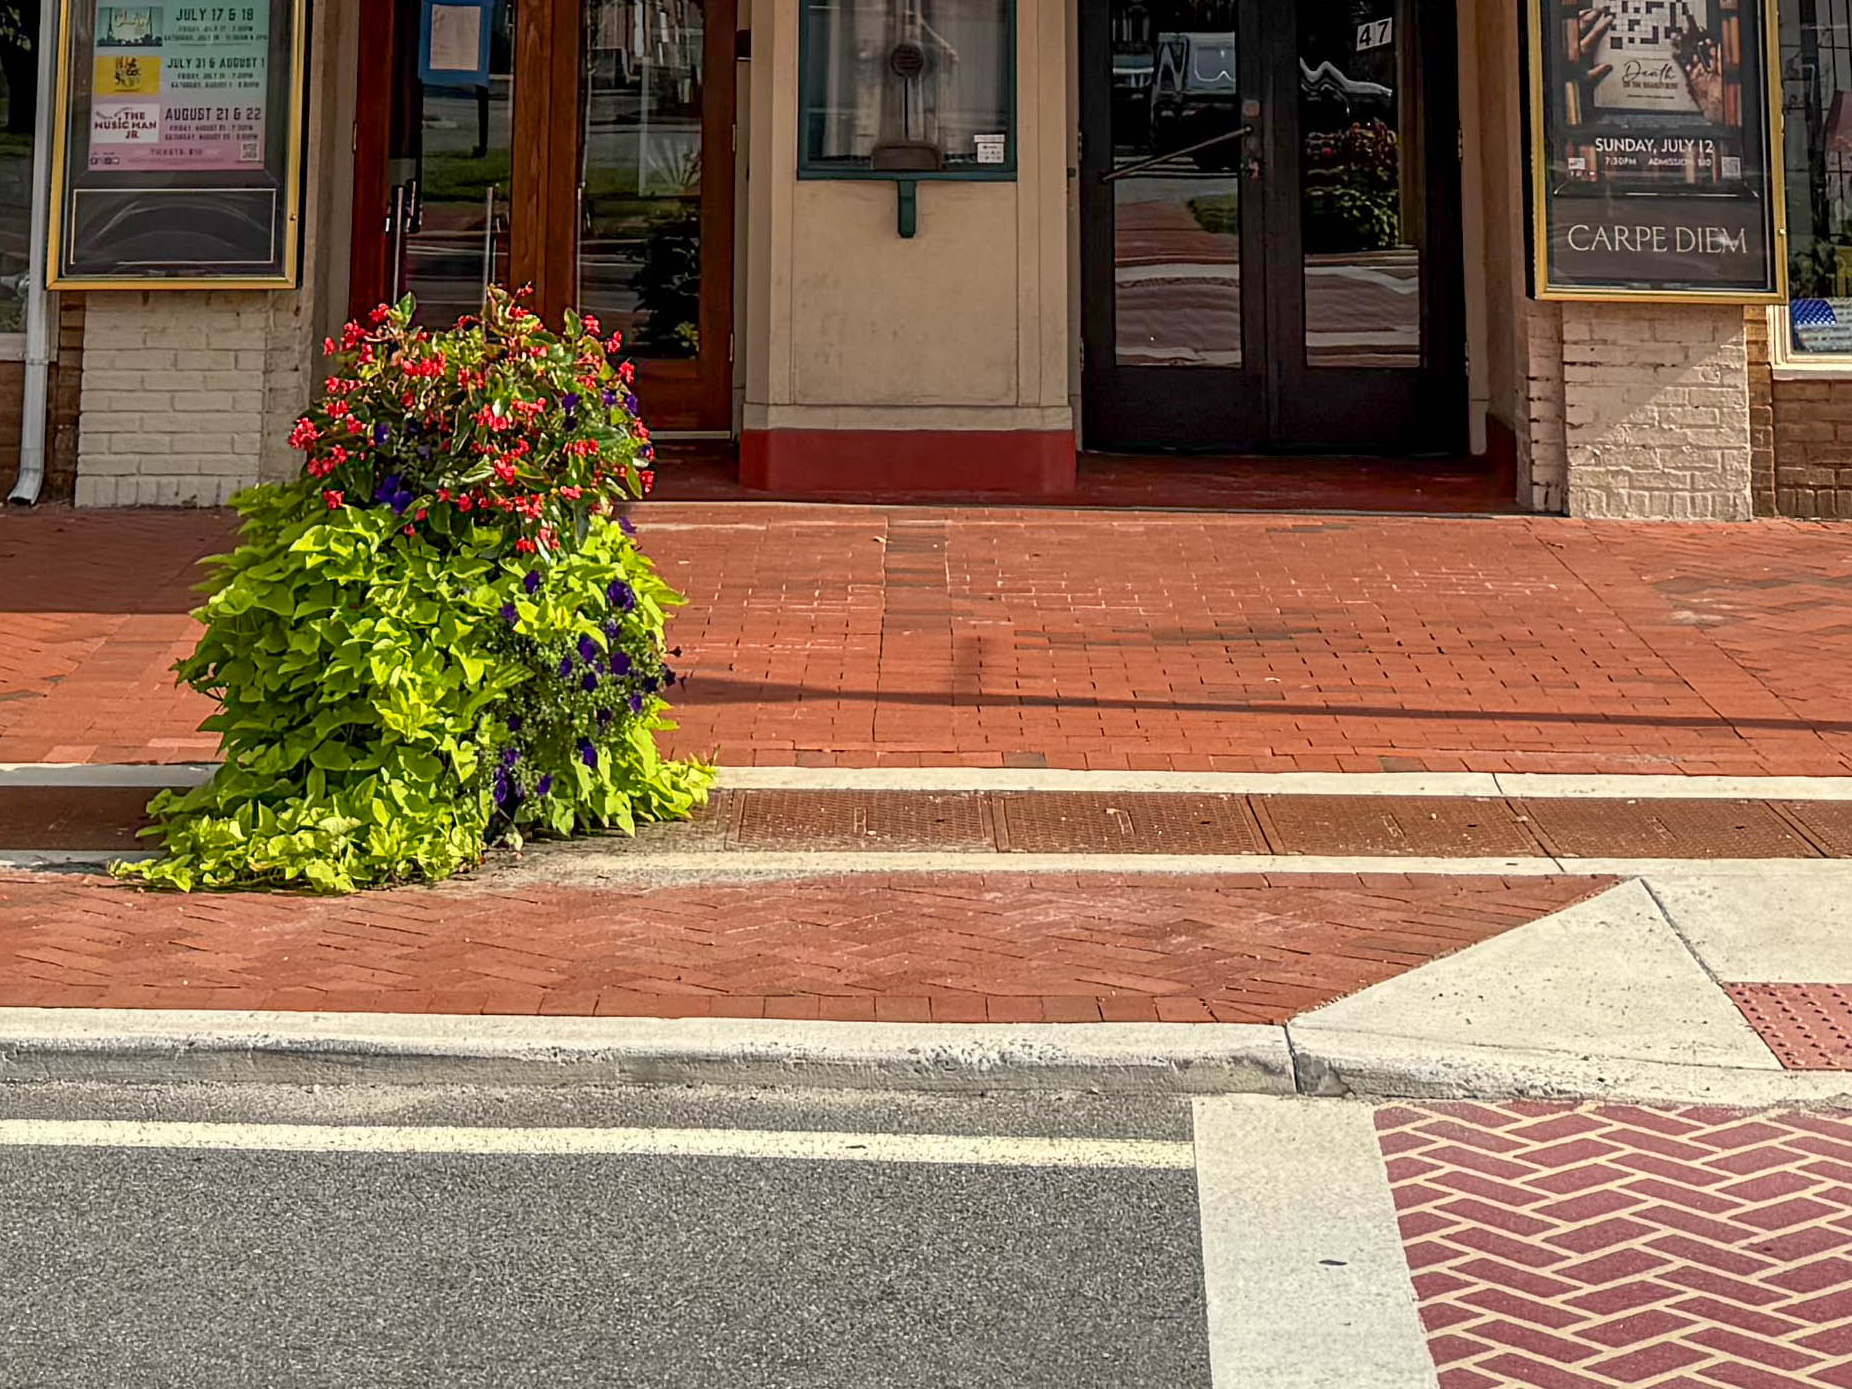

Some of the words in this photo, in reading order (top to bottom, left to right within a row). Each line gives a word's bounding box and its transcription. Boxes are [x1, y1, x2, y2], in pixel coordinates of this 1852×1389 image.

[176, 8, 207, 21] JULY
[1359, 21, 1390, 46] 47
[167, 57, 192, 69] JULY
[123, 111, 146, 120] THE
[165, 108, 210, 121] AUGUST
[132, 120, 157, 129] MAN
[1595, 138, 1657, 155] SUNDAY,
[1661, 139, 1694, 153] JULY
[1699, 139, 1714, 154] 12
[1568, 224, 1667, 252] CARPE
[1675, 227, 1748, 254] DIEM
